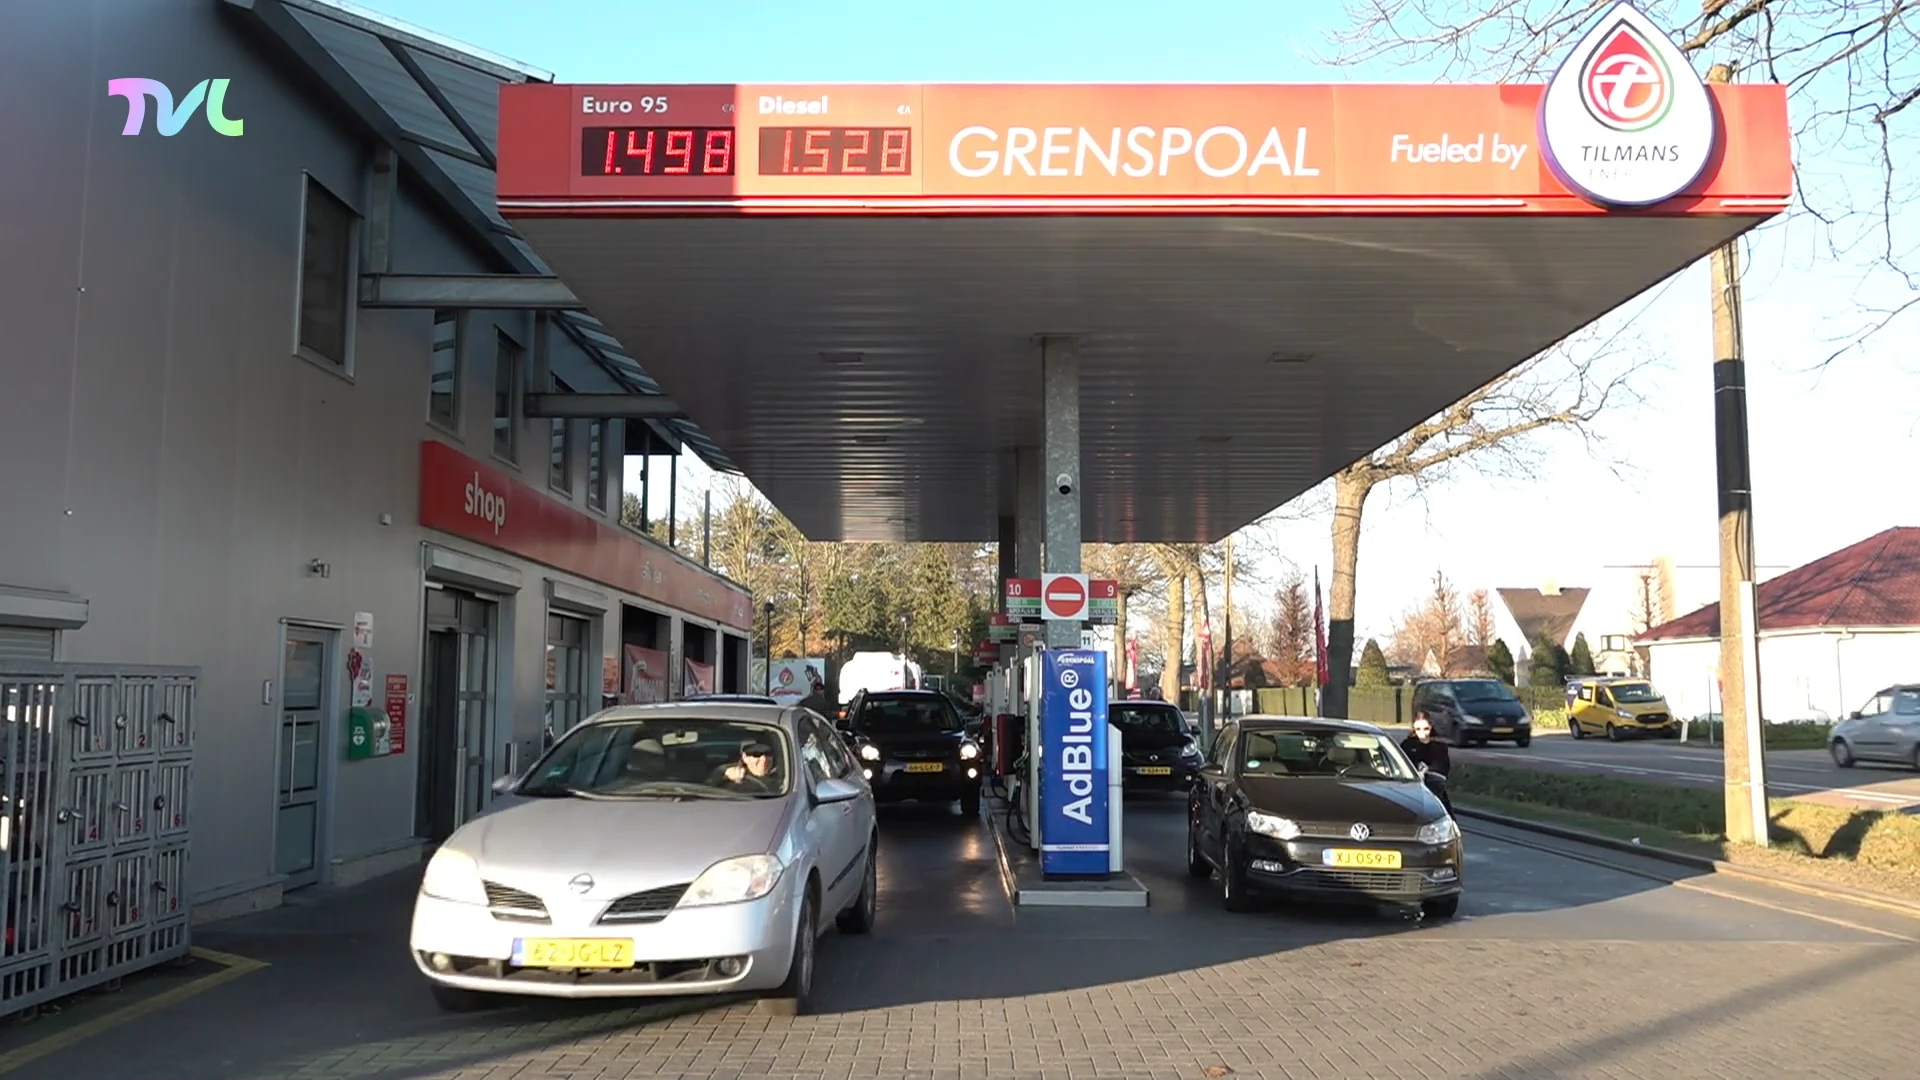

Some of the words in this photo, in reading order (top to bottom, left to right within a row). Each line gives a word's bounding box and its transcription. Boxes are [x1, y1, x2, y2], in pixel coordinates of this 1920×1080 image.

[582, 97, 633, 113] Euro
[640, 97, 668, 113] 95
[758, 96, 829, 115] Diesel
[604, 130, 732, 173] 1.498
[782, 130, 909, 173] 1.528
[948, 125, 1320, 178] GRENSPOAL
[1390, 133, 1485, 164] Fueled
[1492, 133, 1528, 171] by
[1580, 144, 1681, 162] TILMANS
[464, 472, 506, 536] shop
[1008, 583, 1022, 596] 10
[1107, 584, 1115, 597] 9
[1082, 636, 1091, 646] 11
[139, 733, 147, 748] 2
[177, 731, 184, 745] 3
[135, 819, 142, 833] 5
[174, 814, 181, 827] 6
[89, 825, 98, 840] 4
[170, 896, 178, 911] 9
[131, 906, 139, 922] 8
[85, 918, 94, 934] 7
[533, 943, 623, 963] 62-JG-LZ
